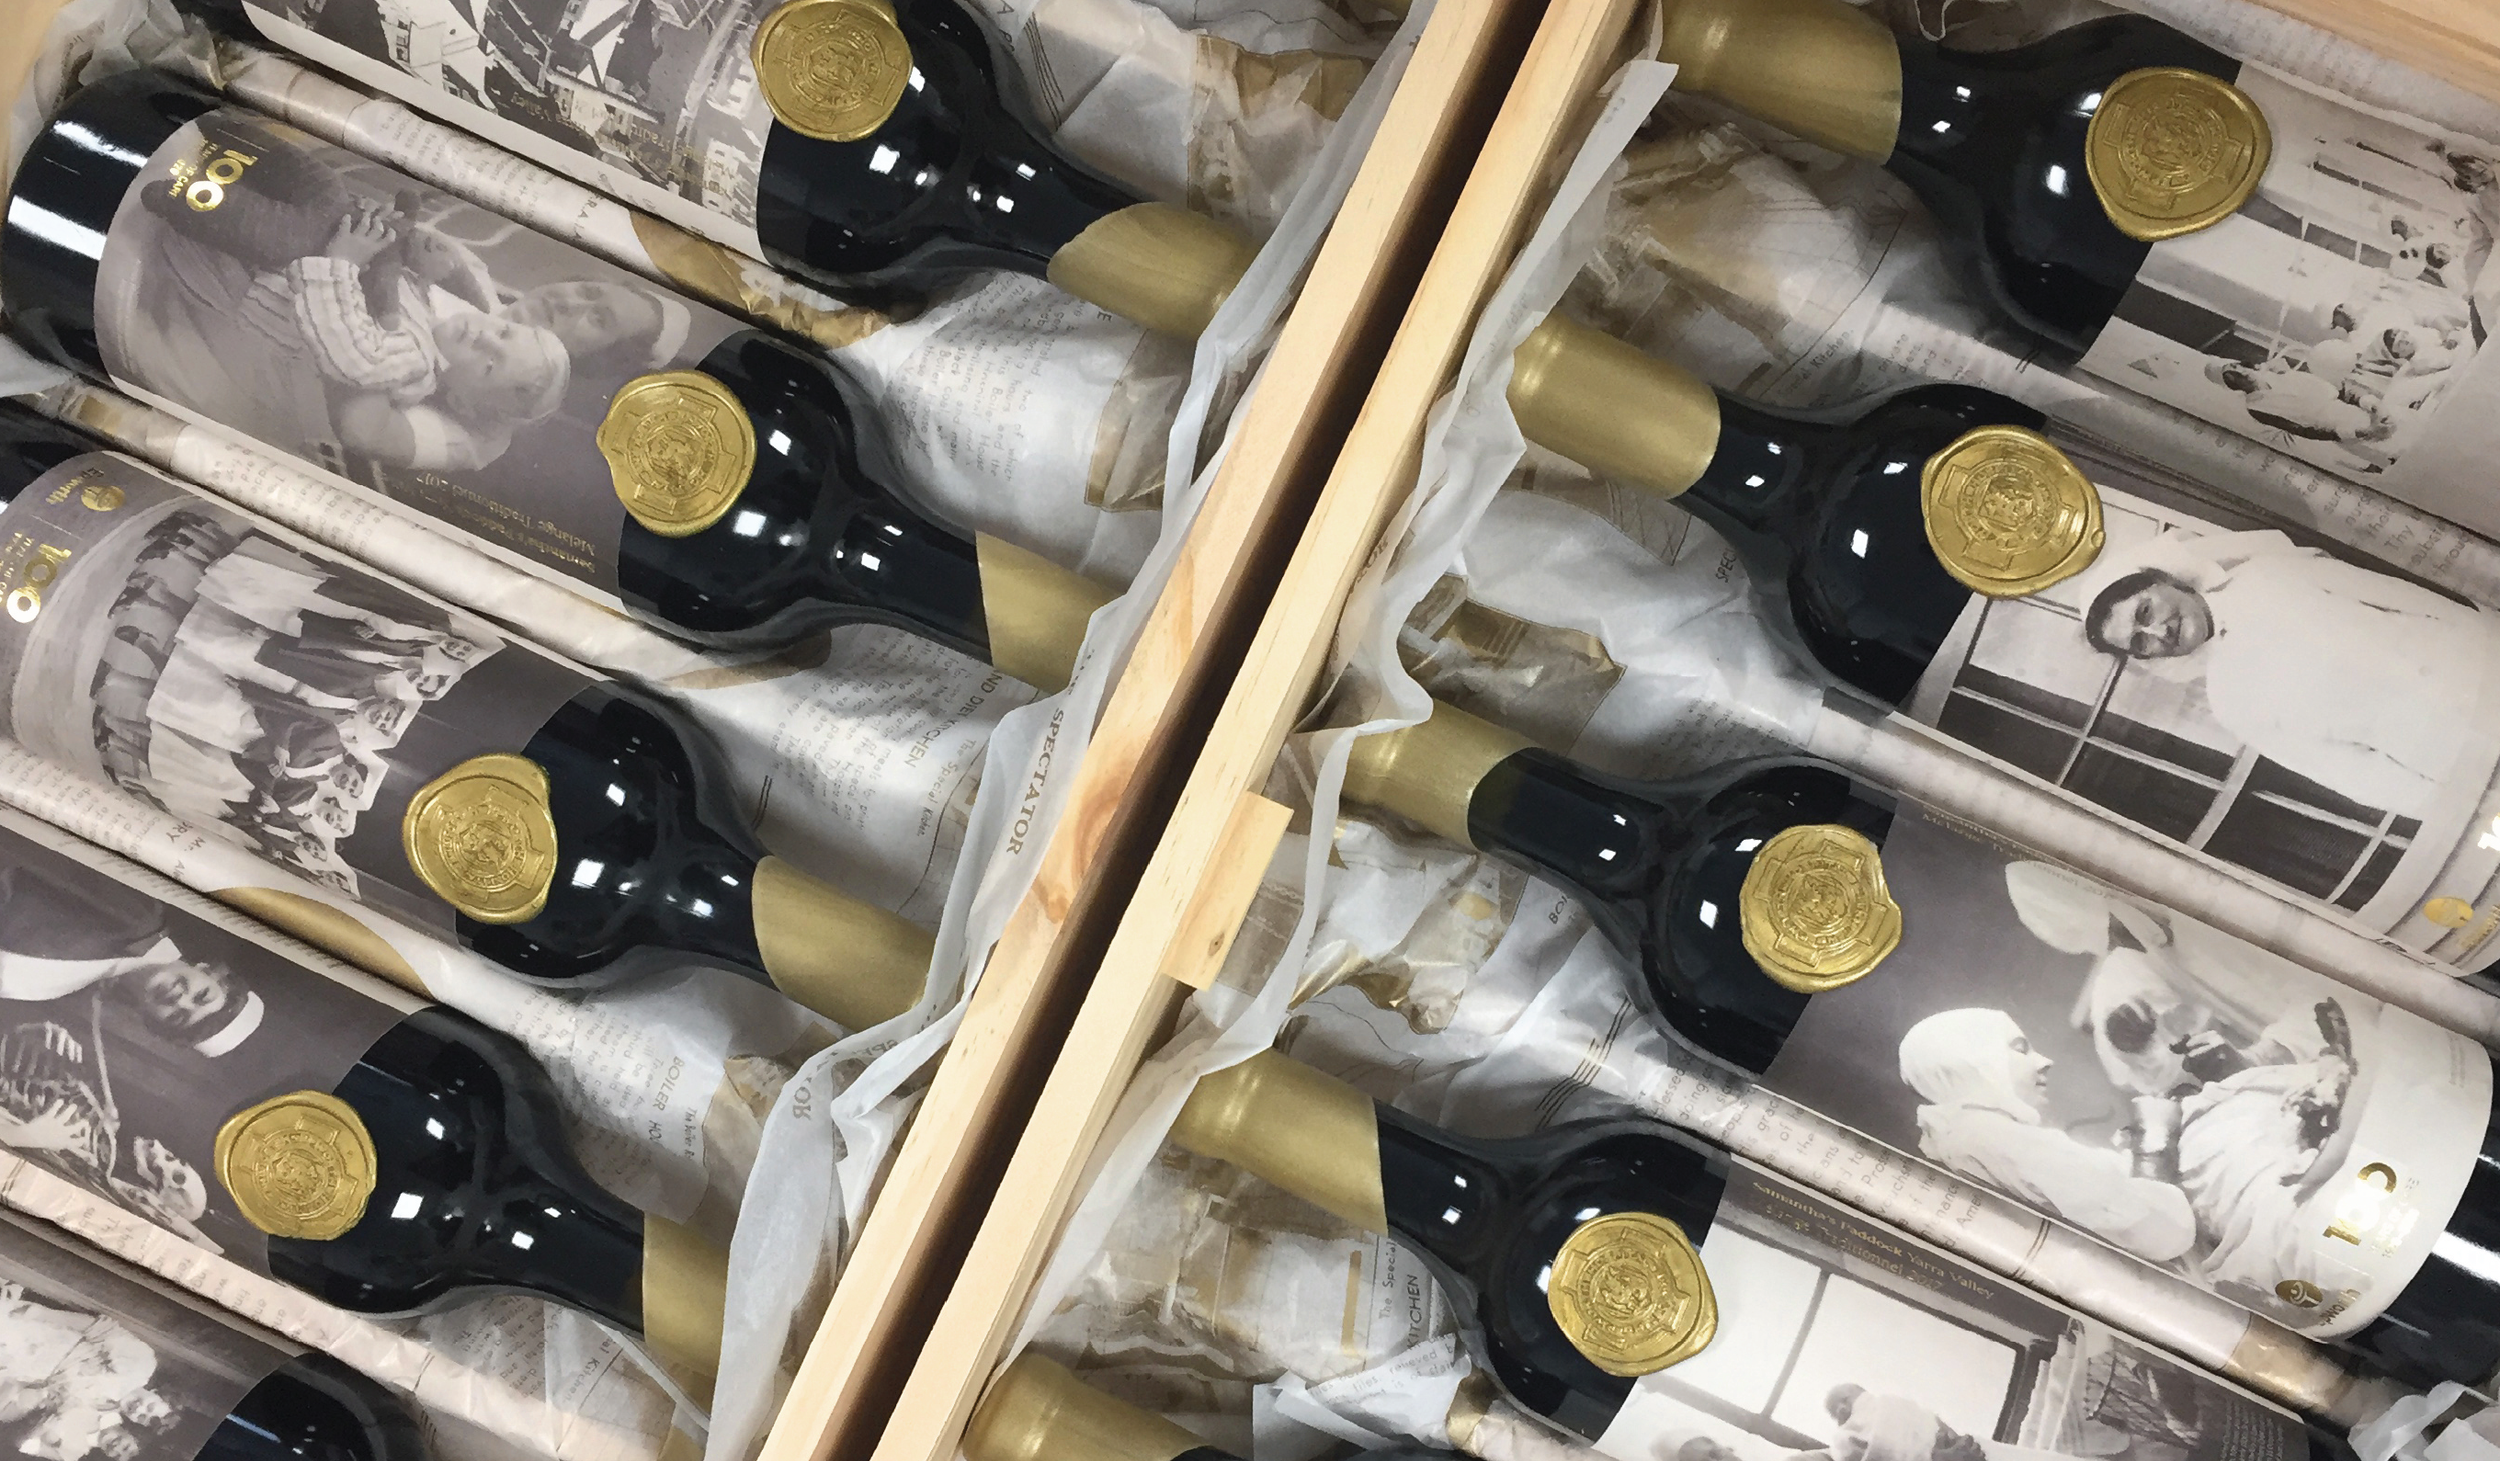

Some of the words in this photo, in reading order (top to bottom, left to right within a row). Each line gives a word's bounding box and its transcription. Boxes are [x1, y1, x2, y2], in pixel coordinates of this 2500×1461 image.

[187, 150, 259, 212] 100
[927, 348, 952, 387] Boiler
[1809, 324, 1856, 370] Kitchen.
[982, 386, 1003, 424] Boiler
[46, 466, 104, 506] Epworth
[2385, 522, 2414, 552] Thy
[6, 543, 73, 624] 100
[812, 722, 840, 761] paved
[925, 759, 959, 804] Special
[1006, 706, 1065, 855] SPECTATOR
[182, 833, 204, 856] Mr.
[1545, 894, 1571, 925] BOI
[630, 1061, 644, 1079] be
[652, 1054, 685, 1112] BOILER
[1750, 1179, 1838, 1227] Samantha's
[1837, 1220, 1904, 1258] Paddock
[1904, 1252, 1945, 1278] Yarra
[1945, 1270, 1995, 1301] Valley
[1381, 1240, 1398, 1288] Special
[1377, 1296, 1393, 1320] The
[1406, 1273, 1423, 1350] KITCHEN
